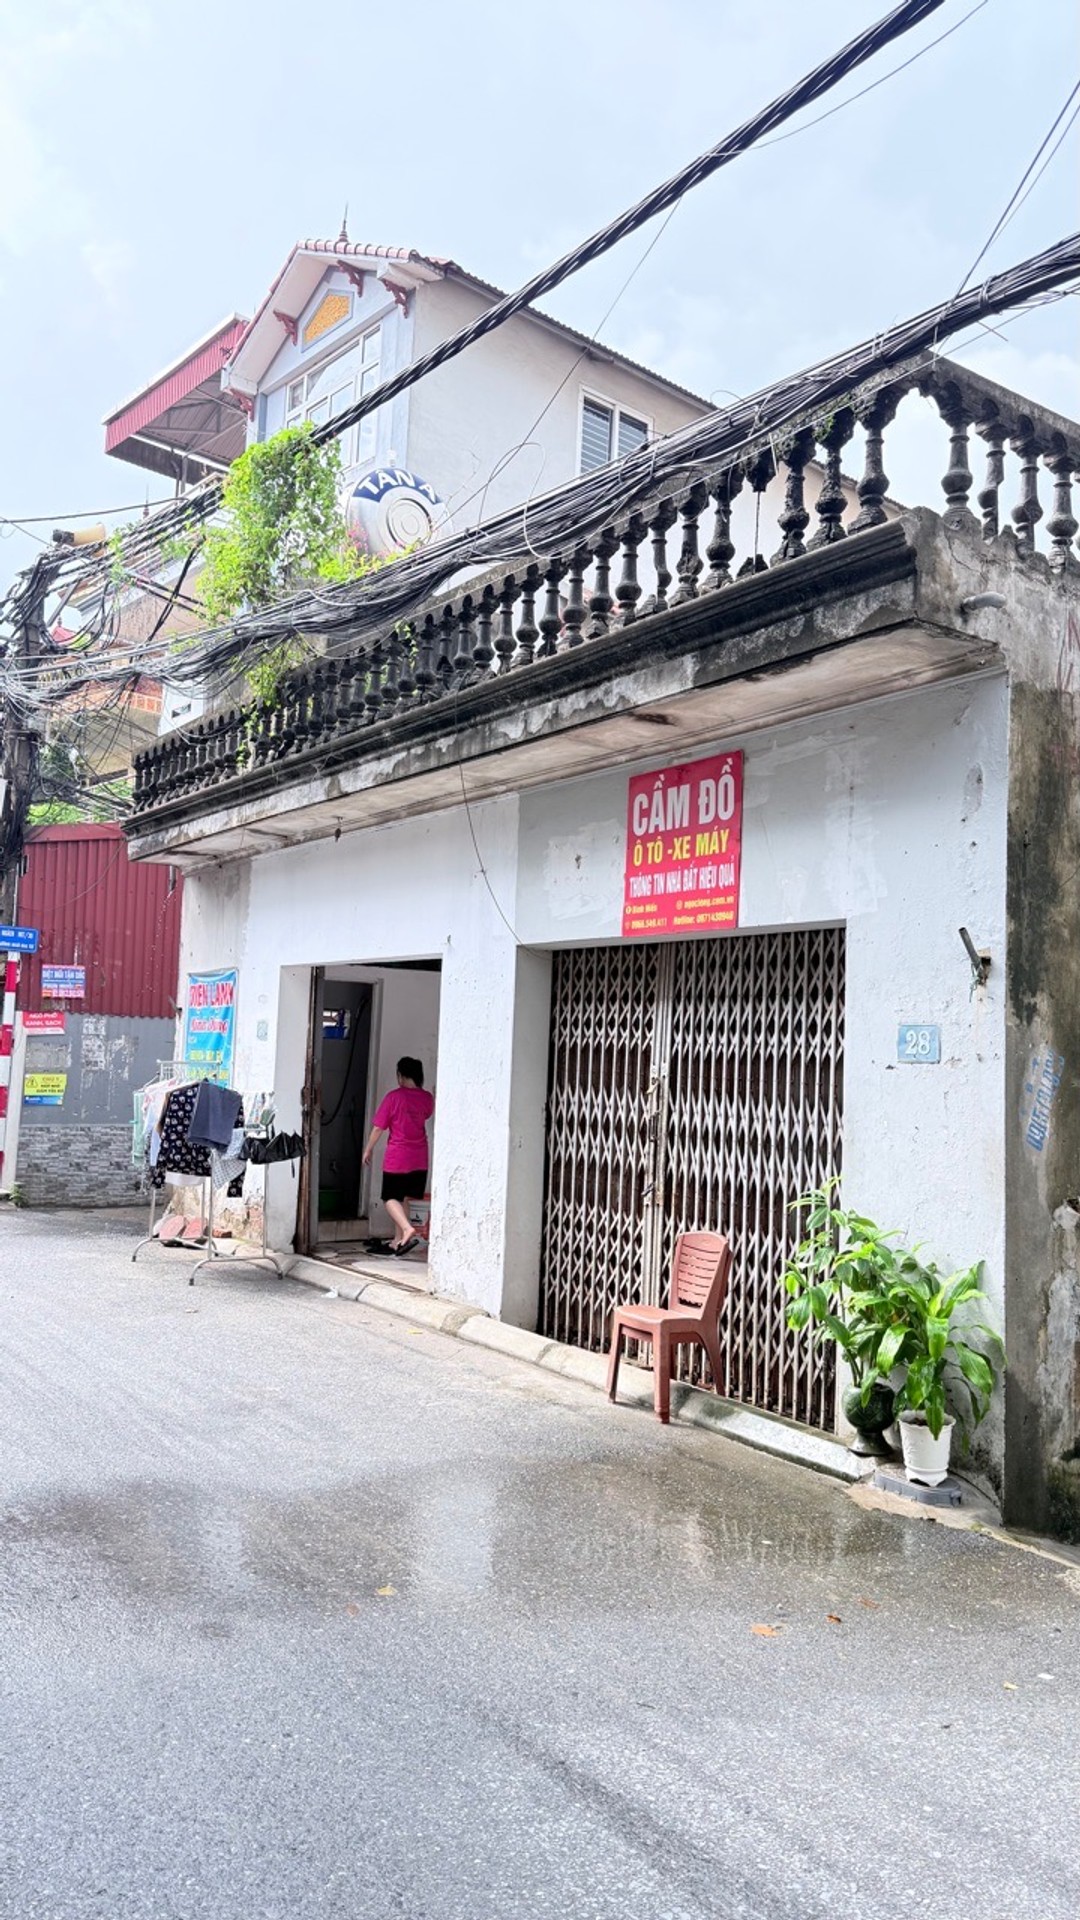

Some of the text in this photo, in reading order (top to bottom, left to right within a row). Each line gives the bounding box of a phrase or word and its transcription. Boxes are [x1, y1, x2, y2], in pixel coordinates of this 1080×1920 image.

[632, 757, 735, 837] CẦM ĐỒ
[633, 839, 643, 867] Ô
[647, 836, 663, 864] TÔ
[695, 826, 730, 858] MÁY
[653, 872, 666, 896] TIN
[905, 1029, 931, 1055] 28
